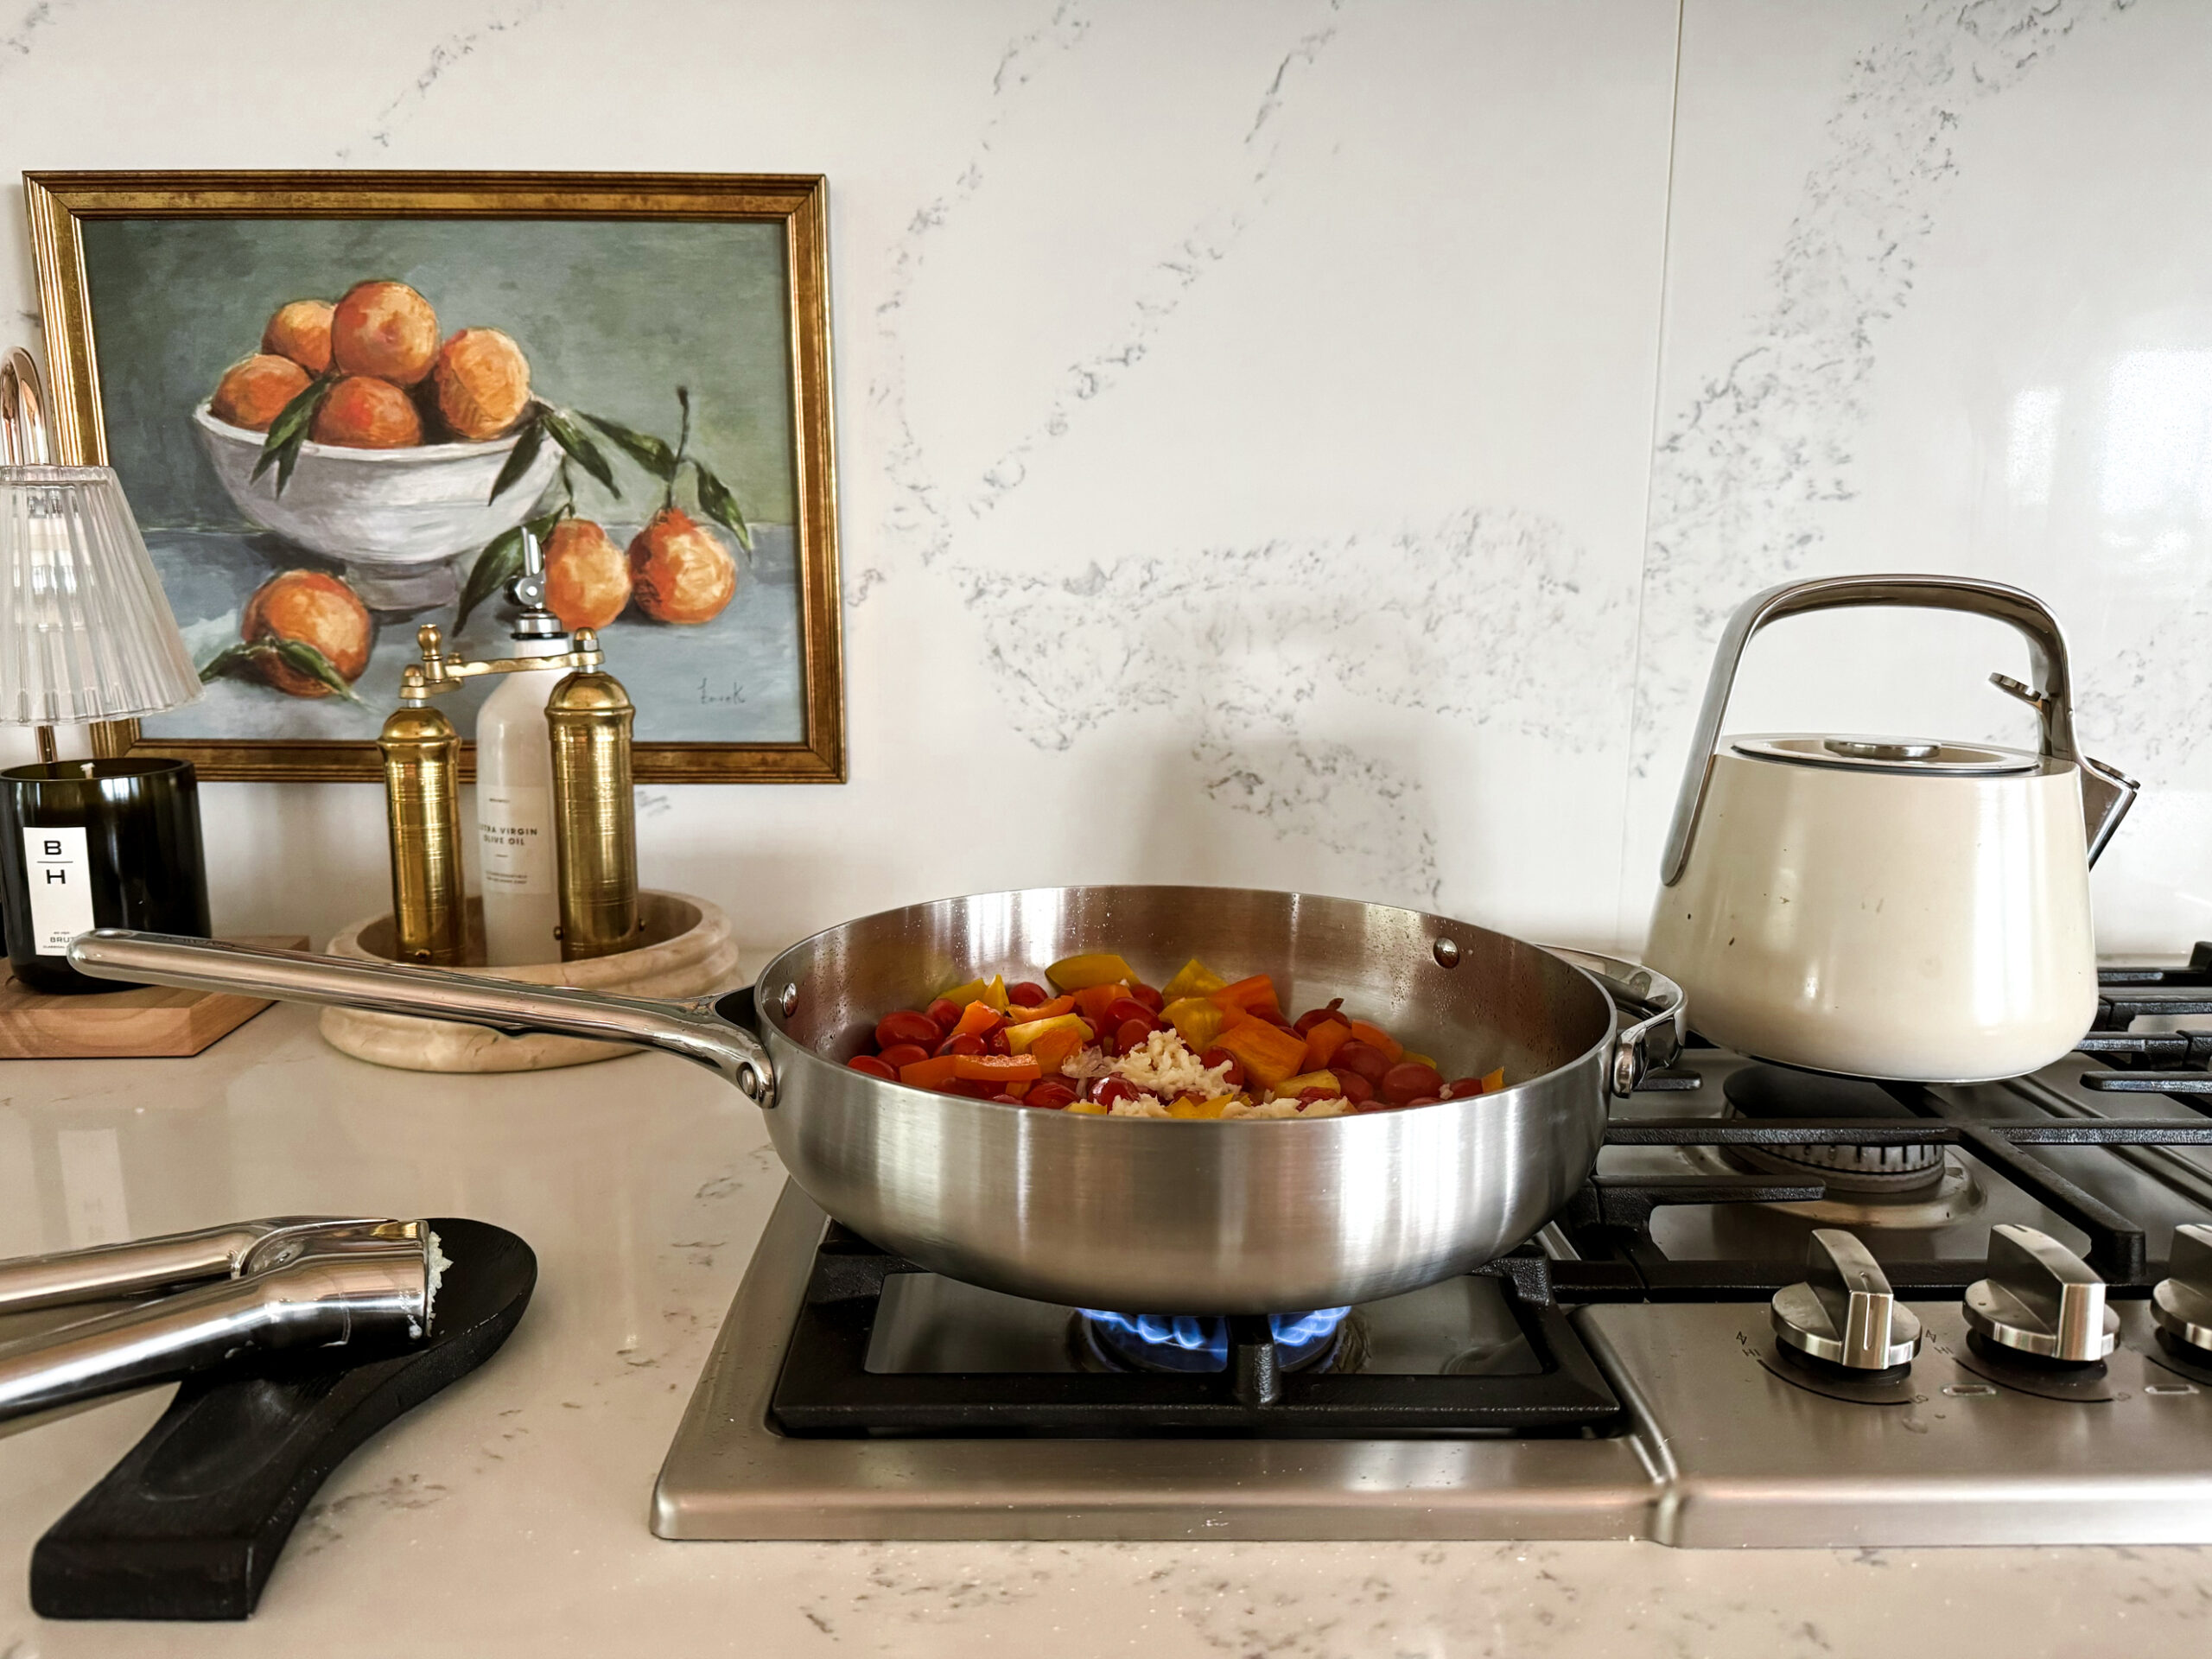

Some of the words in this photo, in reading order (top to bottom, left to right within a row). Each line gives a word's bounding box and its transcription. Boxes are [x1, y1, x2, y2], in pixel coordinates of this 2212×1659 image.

[478, 823, 497, 833] TRA
[499, 827, 537, 836] VIRGIN
[483, 834, 504, 844] OLIVE
[508, 837, 525, 846] OIL
[44, 840, 62, 855] B
[46, 869, 66, 885] H
[1741, 1348, 1762, 1357] HI
